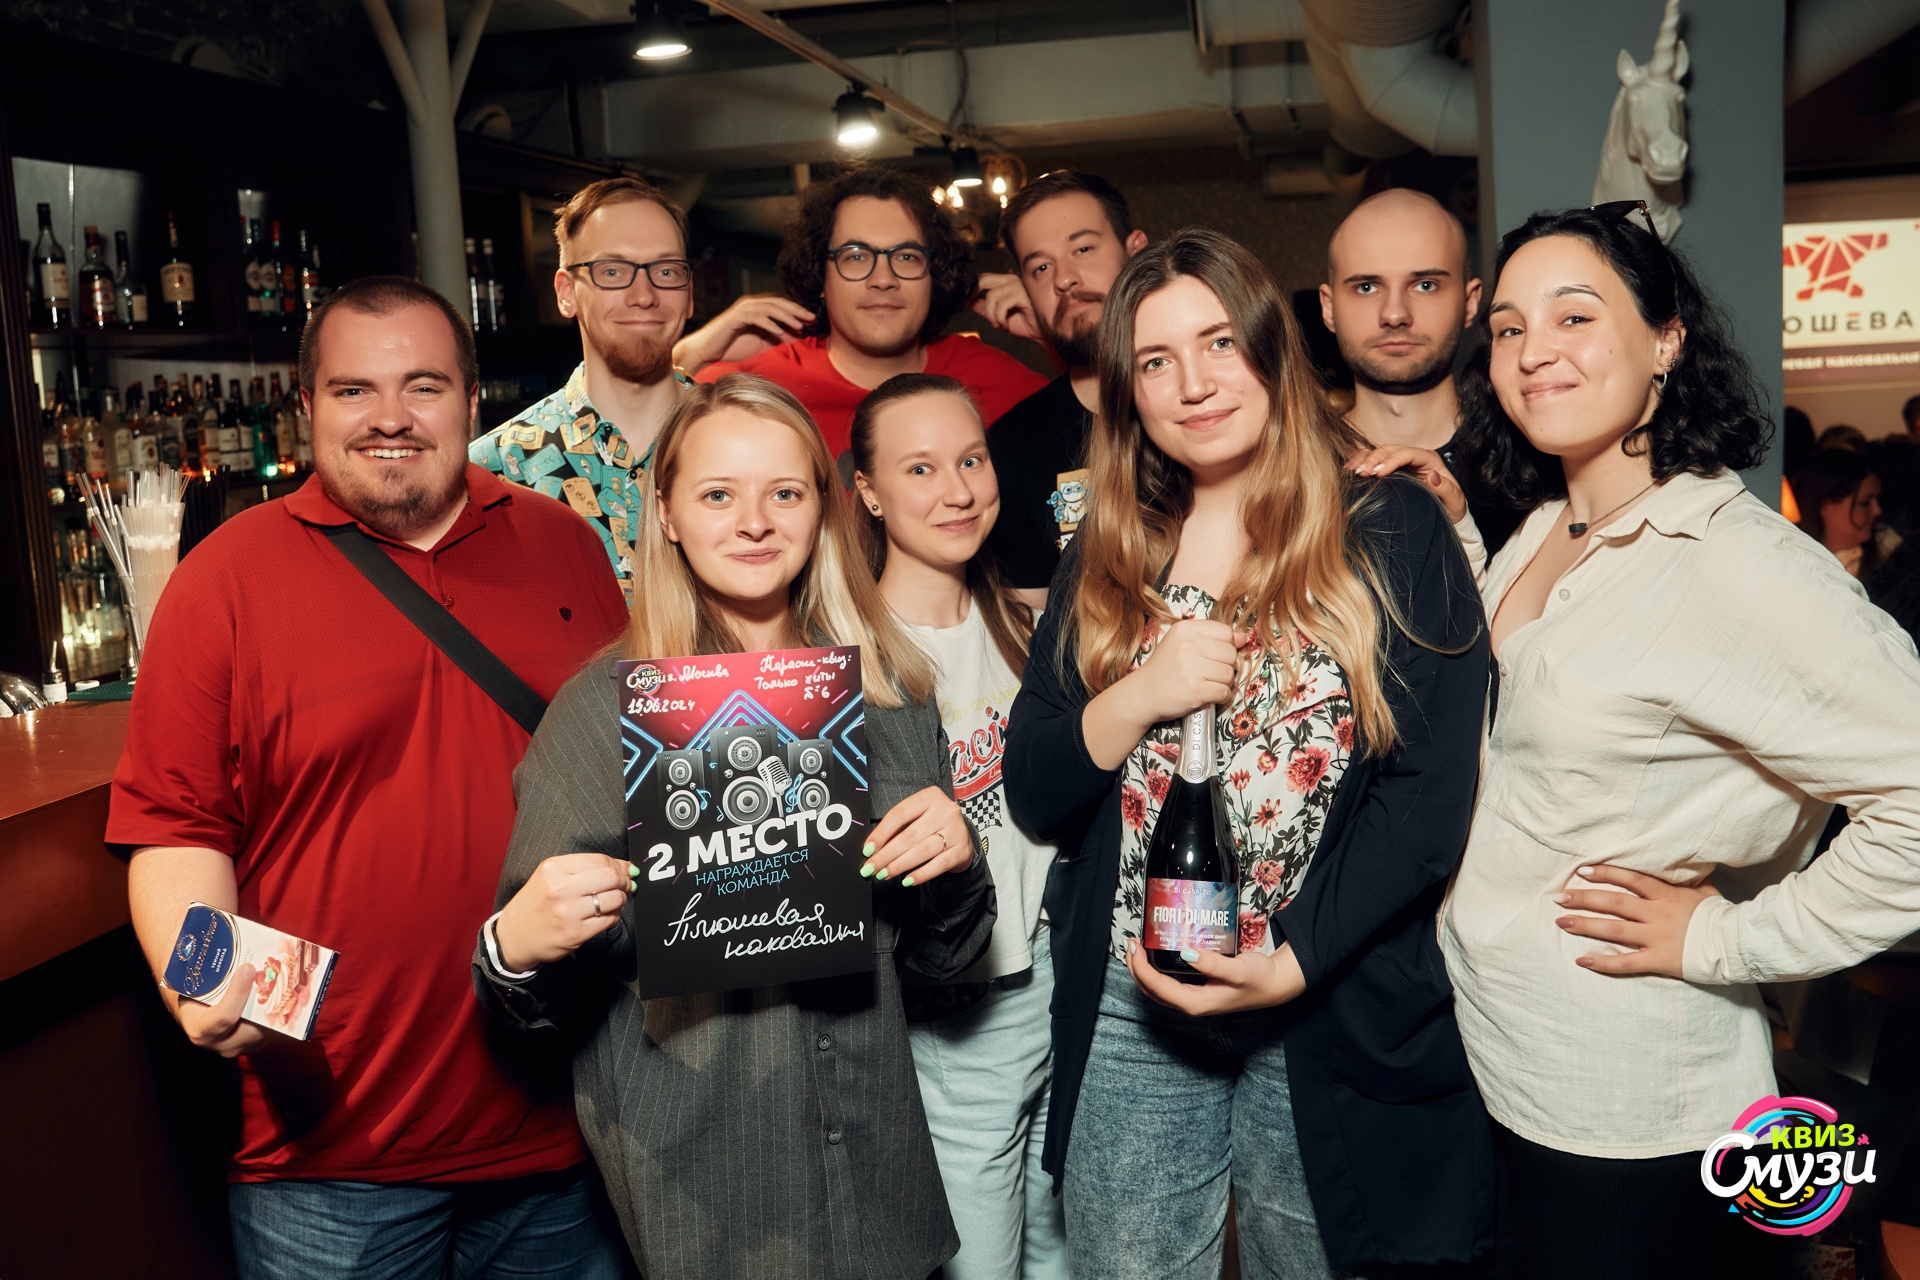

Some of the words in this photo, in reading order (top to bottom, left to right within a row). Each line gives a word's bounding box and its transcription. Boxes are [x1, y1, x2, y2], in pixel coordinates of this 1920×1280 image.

[626, 673, 666, 689] Смузи
[641, 668, 661, 677] КВИЗ
[679, 663, 729, 682] Москва
[753, 676, 798, 690] Только
[804, 672, 835, 684] хиты
[1192, 710, 1202, 735] CAS
[648, 843, 676, 882] 2
[686, 803, 852, 873] МЕСТО
[694, 848, 809, 886] НАГРАЖДАЕТСЯ
[716, 869, 790, 896] КОМАНДА
[664, 892, 825, 947] Плюшевая
[1153, 906, 1181, 924] FIORI
[1185, 907, 1197, 925] DI
[1200, 909, 1230, 927] MARE
[724, 921, 865, 960] наковальня
